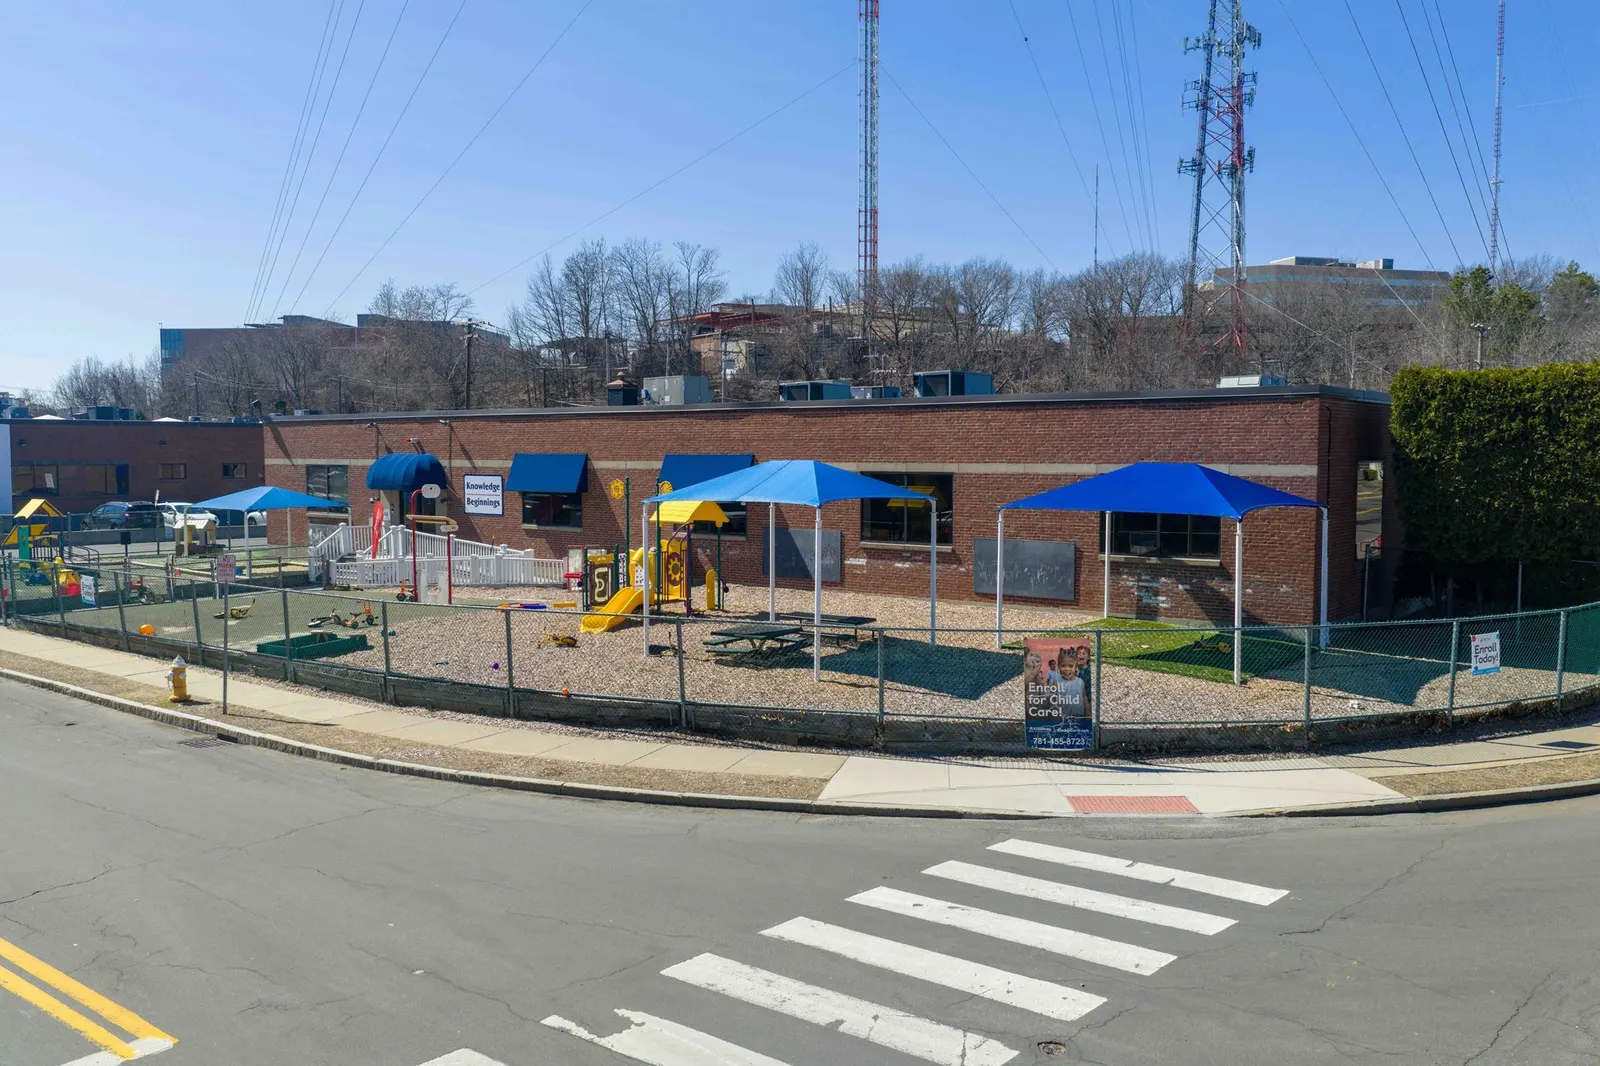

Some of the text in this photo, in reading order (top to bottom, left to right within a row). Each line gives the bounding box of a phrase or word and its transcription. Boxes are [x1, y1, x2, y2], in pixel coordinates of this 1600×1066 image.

[466, 481, 500, 492] Knowledge
[466, 497, 500, 508] Beginnings
[1474, 643, 1497, 654] Enroll
[1474, 652, 1498, 664] Today!
[1028, 682, 1065, 693] Enroll
[1028, 694, 1079, 705] for Child
[1028, 706, 1062, 717] Care!
[1033, 737, 1085, 745] 781-455-8723
